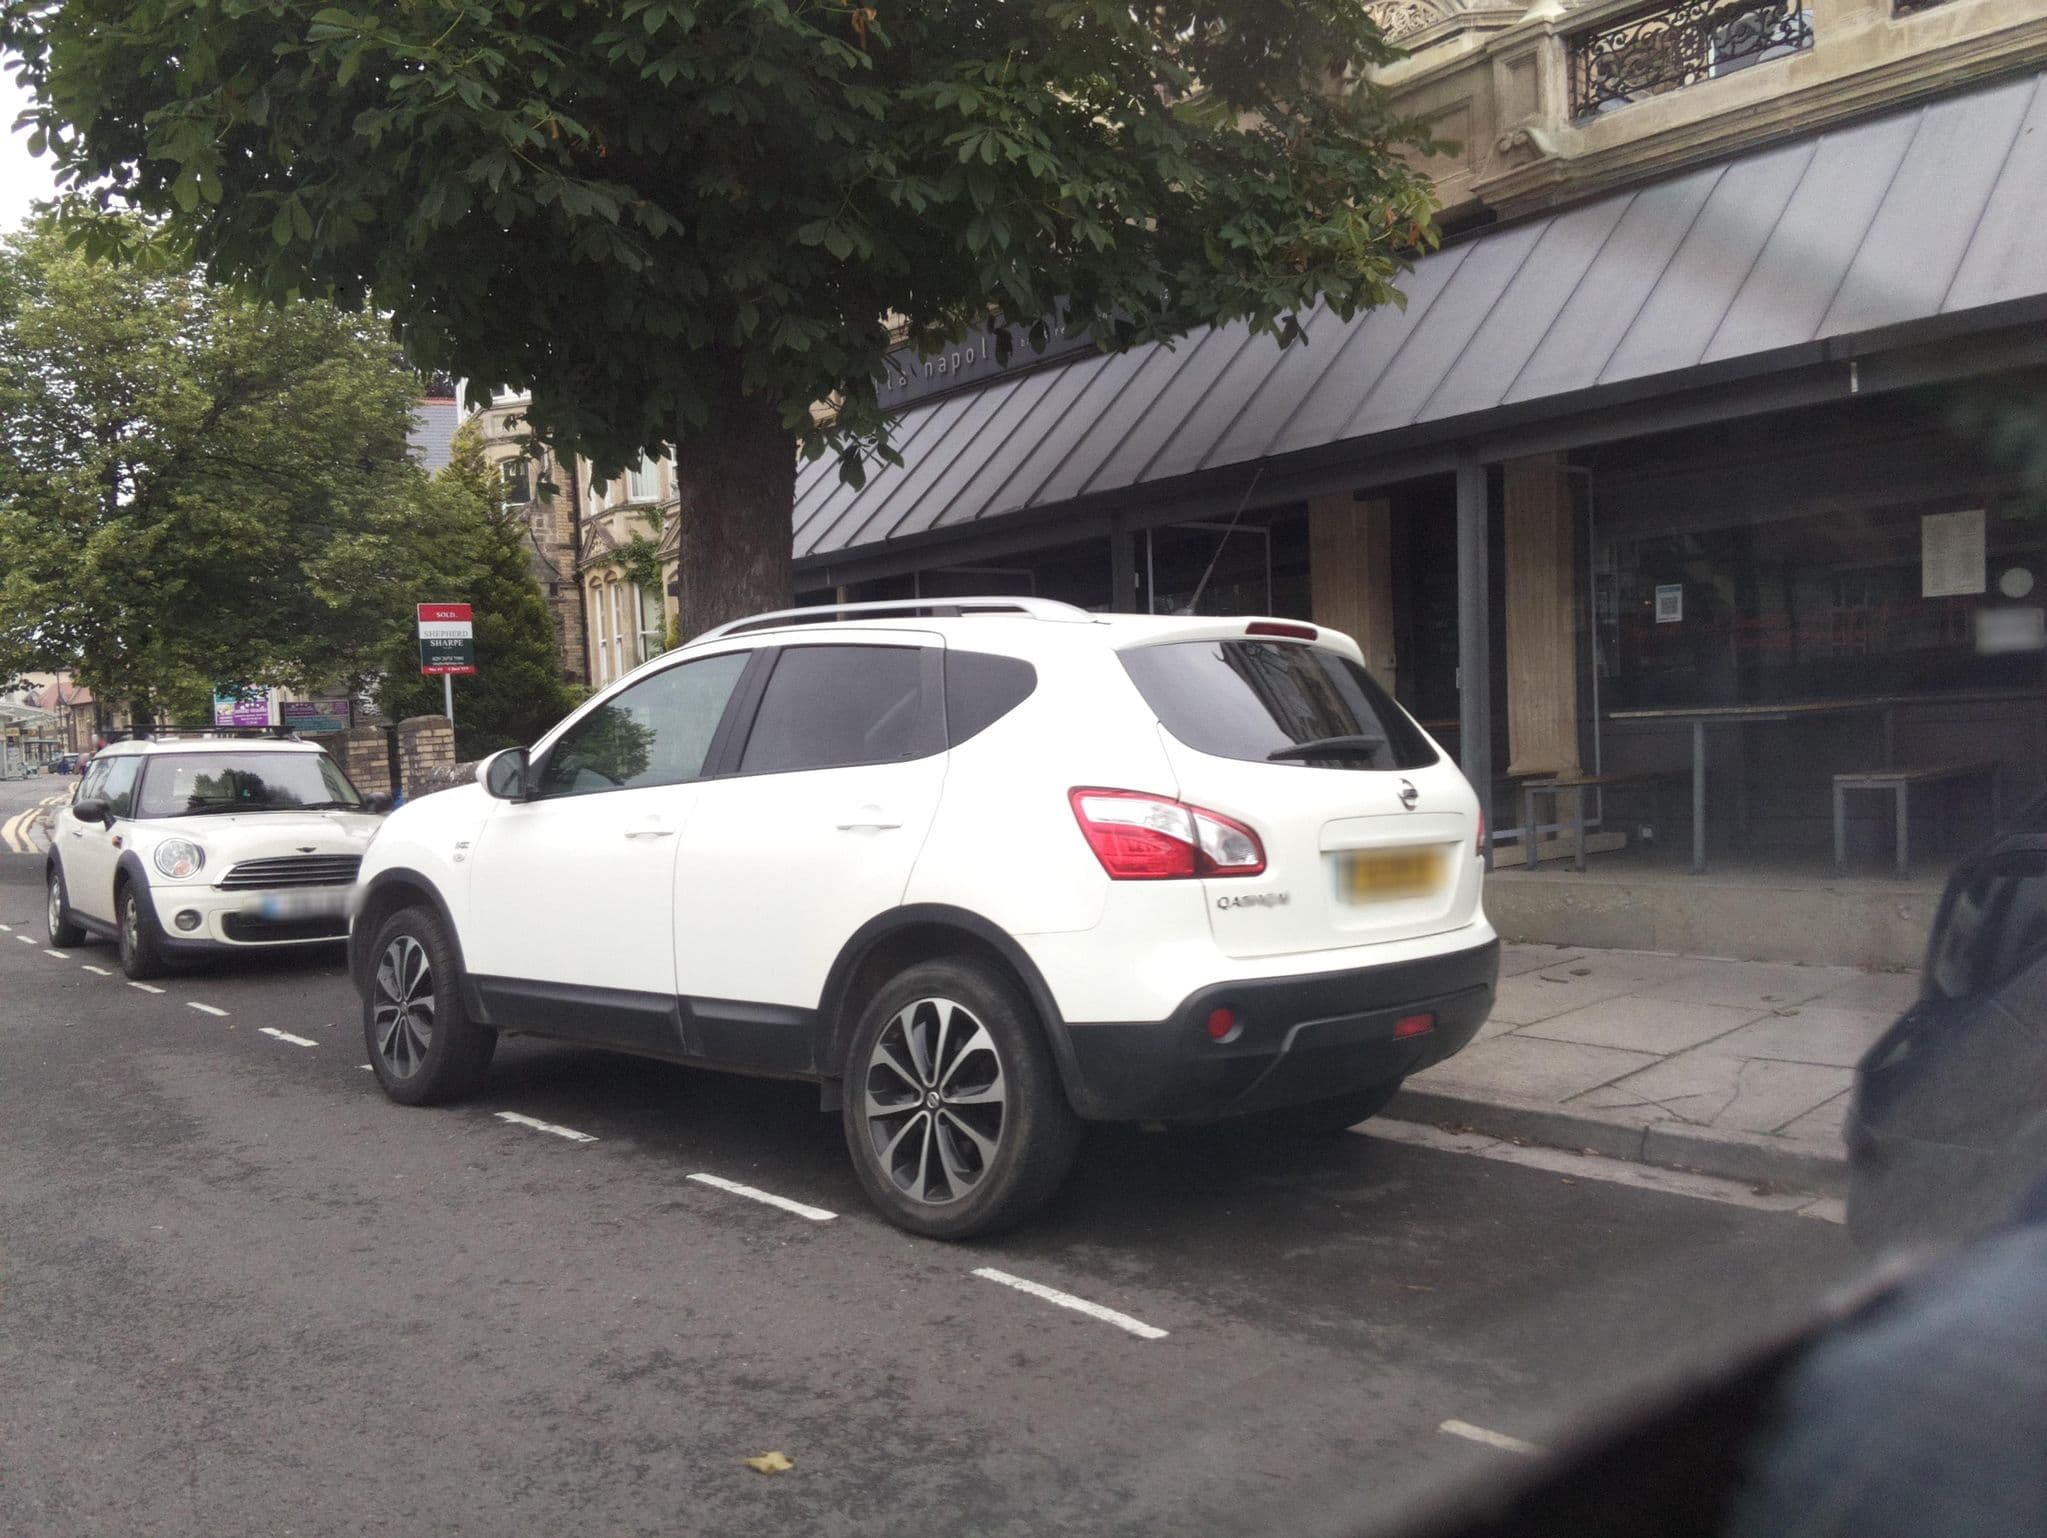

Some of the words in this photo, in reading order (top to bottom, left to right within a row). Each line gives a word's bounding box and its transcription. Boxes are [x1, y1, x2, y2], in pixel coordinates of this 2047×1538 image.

[924, 336, 988, 378] napol
[424, 630, 469, 638] SHEPHERD
[430, 639, 464, 647] SHARPE
